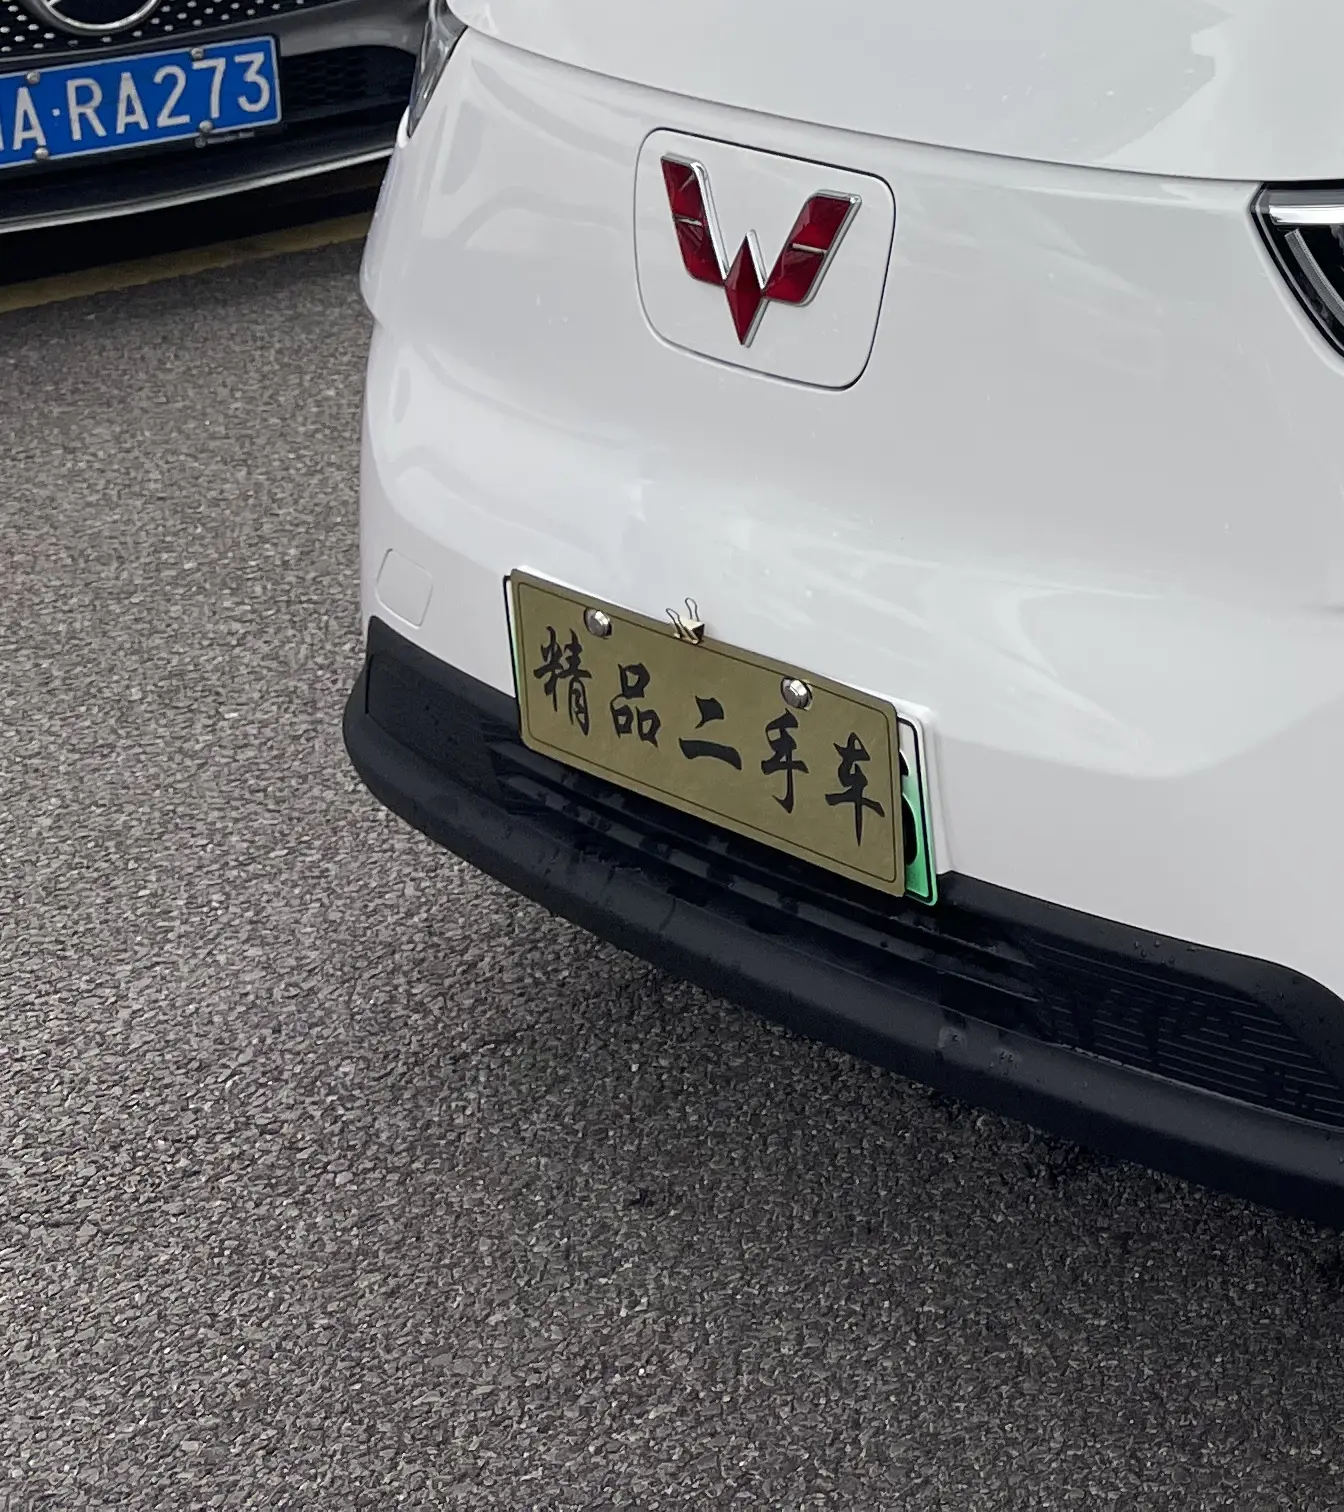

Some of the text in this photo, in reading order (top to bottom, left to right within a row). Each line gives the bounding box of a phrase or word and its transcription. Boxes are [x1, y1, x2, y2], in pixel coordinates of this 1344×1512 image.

[533, 626, 885, 847] 精品二手车
